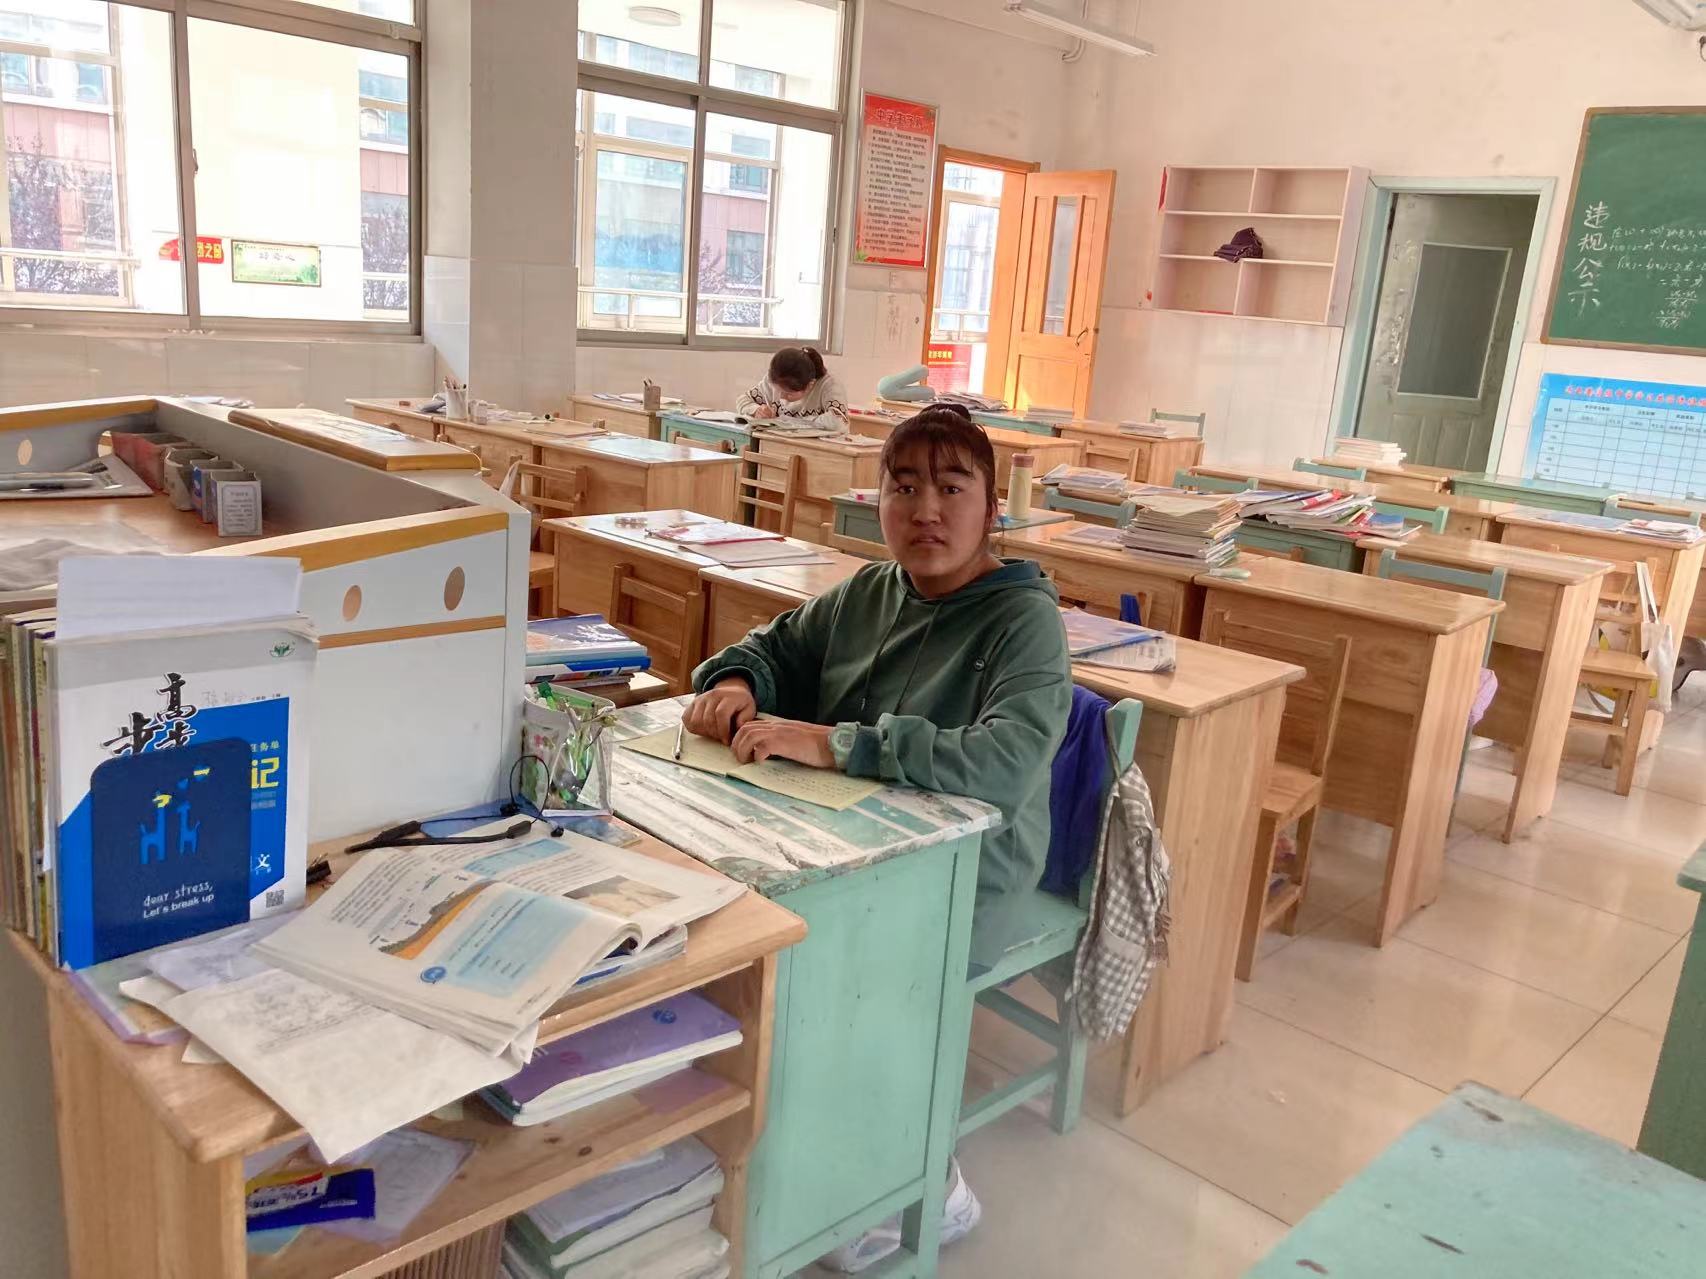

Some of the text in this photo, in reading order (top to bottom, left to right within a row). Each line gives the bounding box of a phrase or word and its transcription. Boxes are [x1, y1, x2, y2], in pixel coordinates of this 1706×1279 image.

[1567, 200, 1611, 318] 违规公示
[144, 881, 214, 907] dear stress,
[171, 896, 200, 911] break
[201, 893, 215, 904] up
